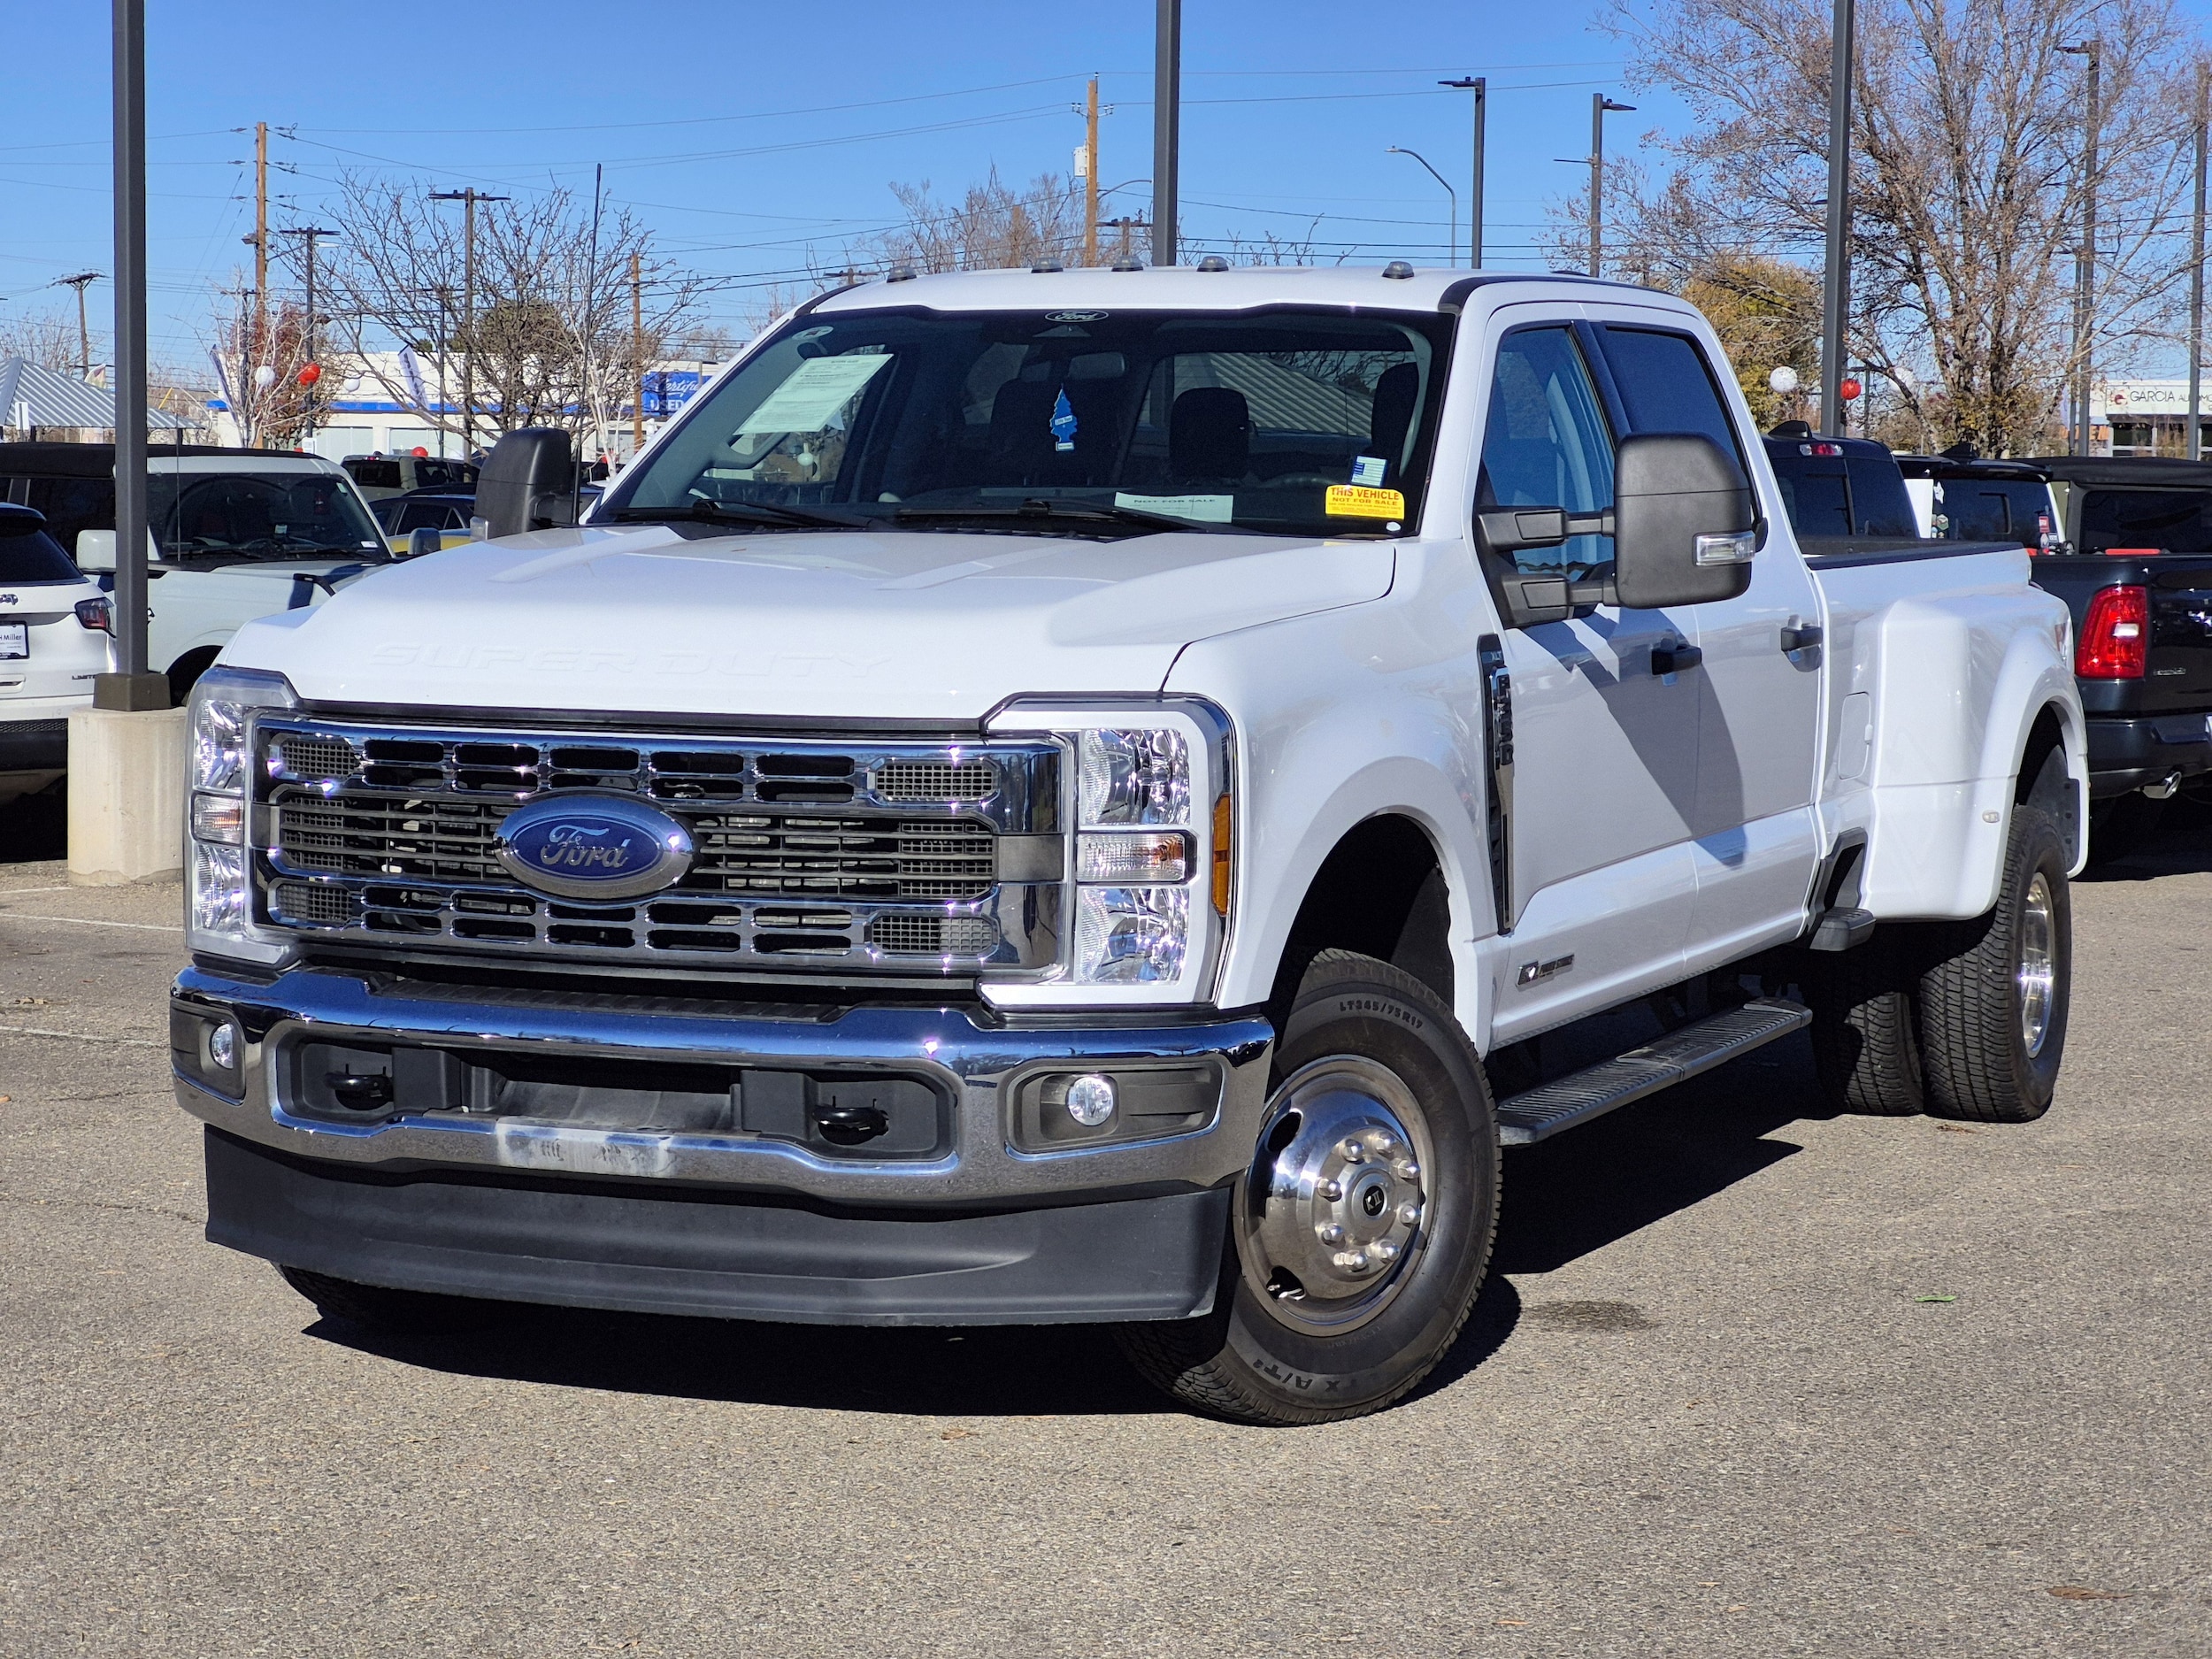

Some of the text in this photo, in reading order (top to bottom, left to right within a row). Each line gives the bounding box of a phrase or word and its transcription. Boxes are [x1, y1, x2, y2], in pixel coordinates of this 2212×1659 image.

[1056, 311, 1098, 320] Ford
[2130, 390, 2175, 403] GARCIA
[1331, 487, 1400, 501] THIS VEHICLE
[368, 641, 893, 679] SUPER DUTY
[1490, 650, 1502, 661] XLT
[541, 824, 631, 868] Ford
